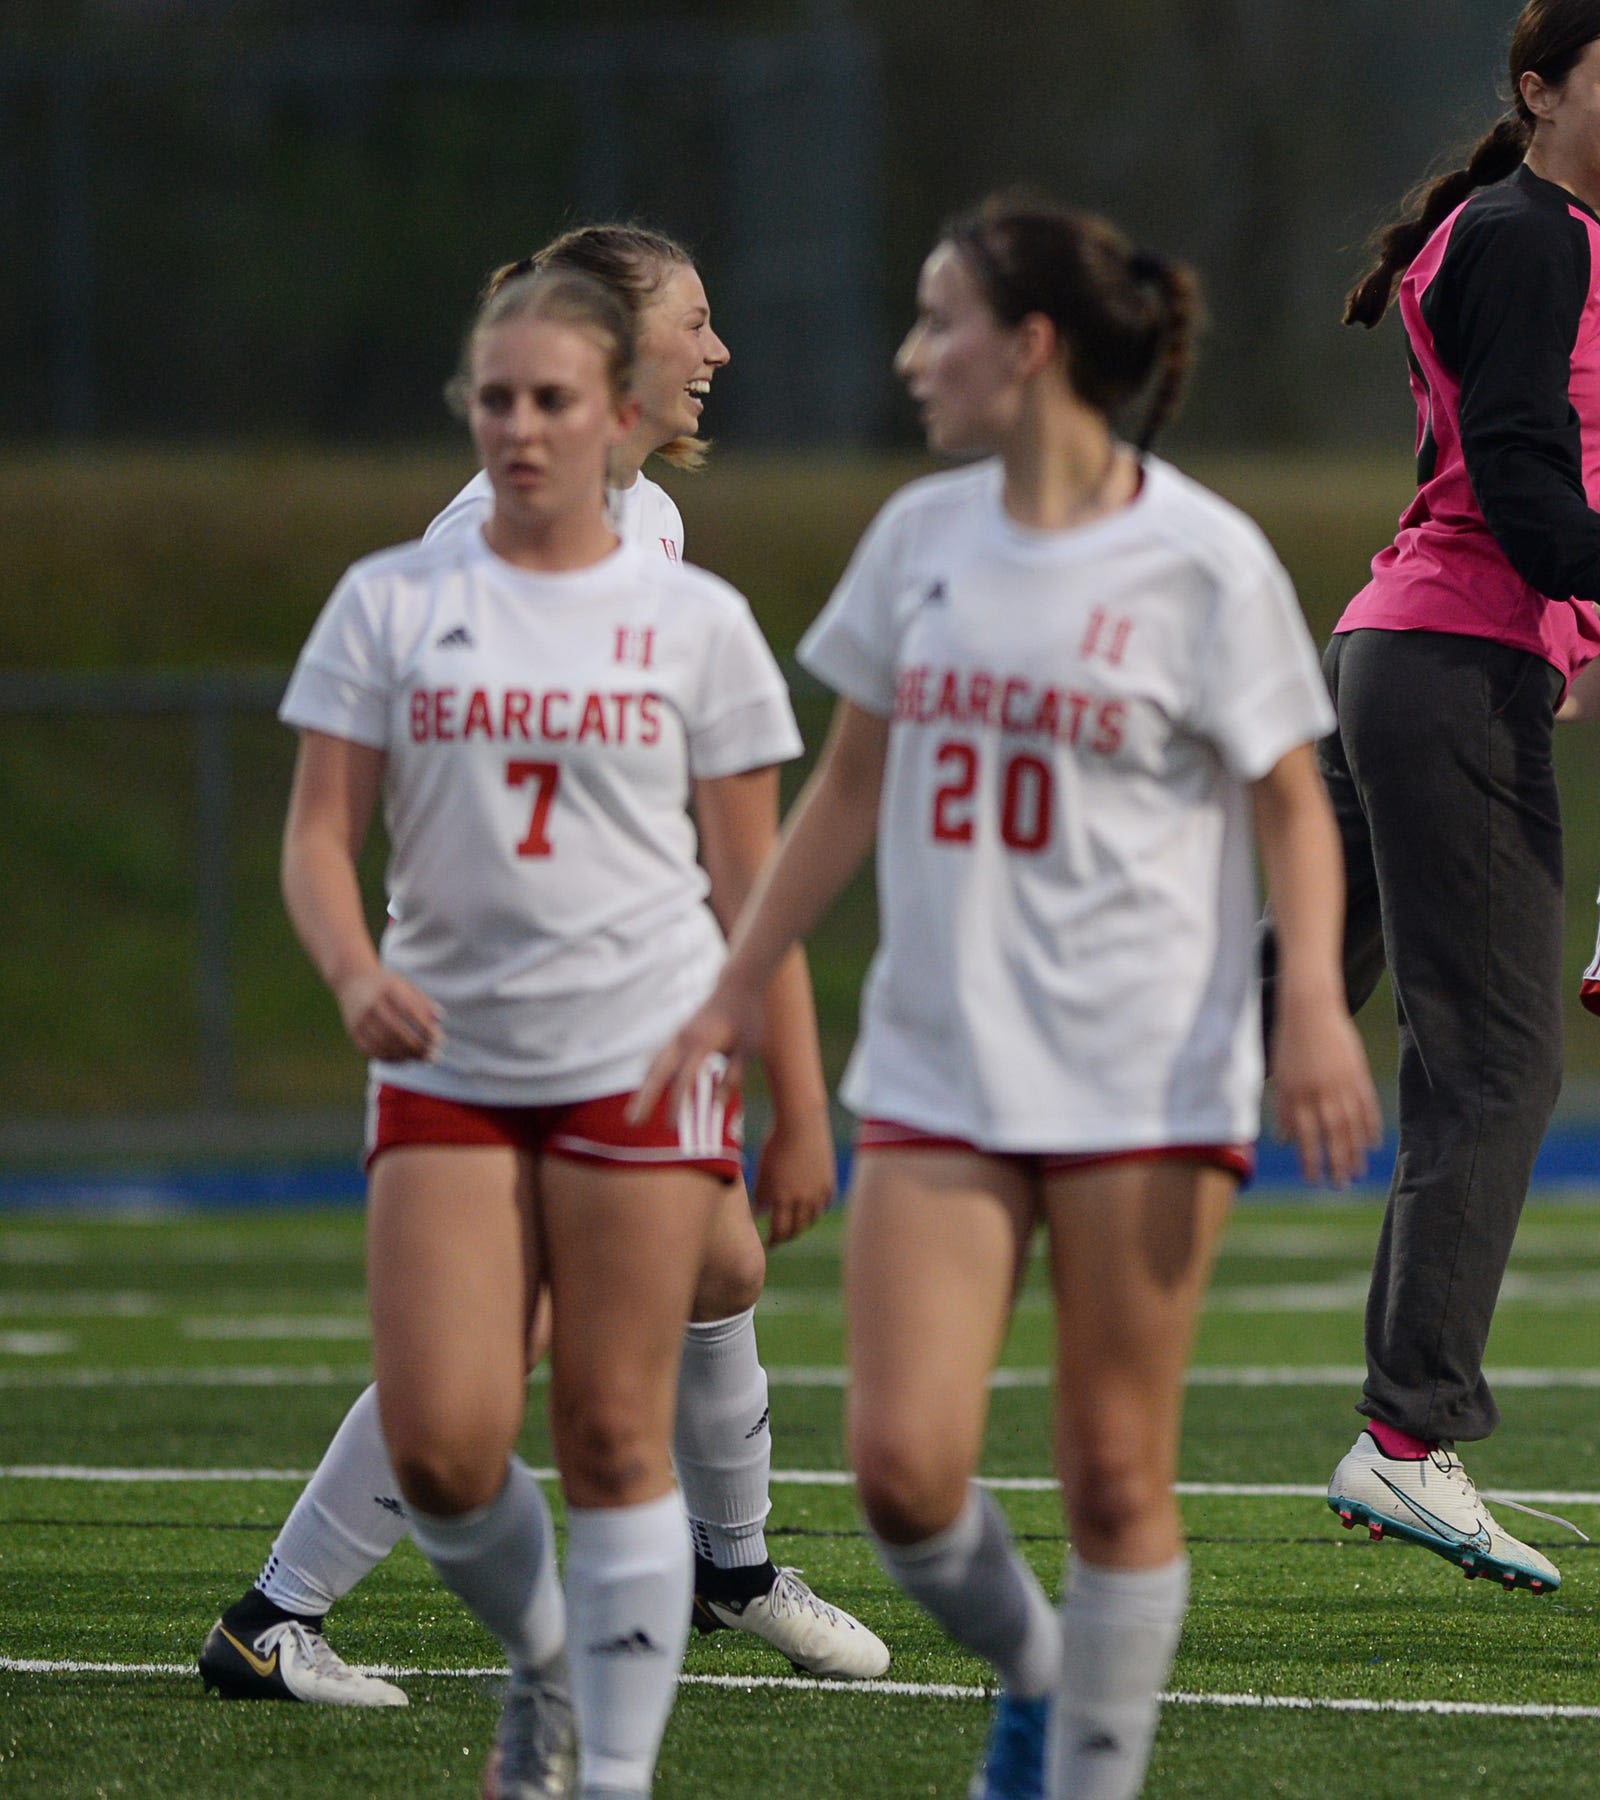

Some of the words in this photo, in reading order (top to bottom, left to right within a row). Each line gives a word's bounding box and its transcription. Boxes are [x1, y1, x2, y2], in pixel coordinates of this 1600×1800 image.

[410, 688, 660, 744] BEARCATS
[894, 668, 1127, 755] BEARCATS
[506, 761, 558, 857] 7
[934, 740, 1055, 852] 20
